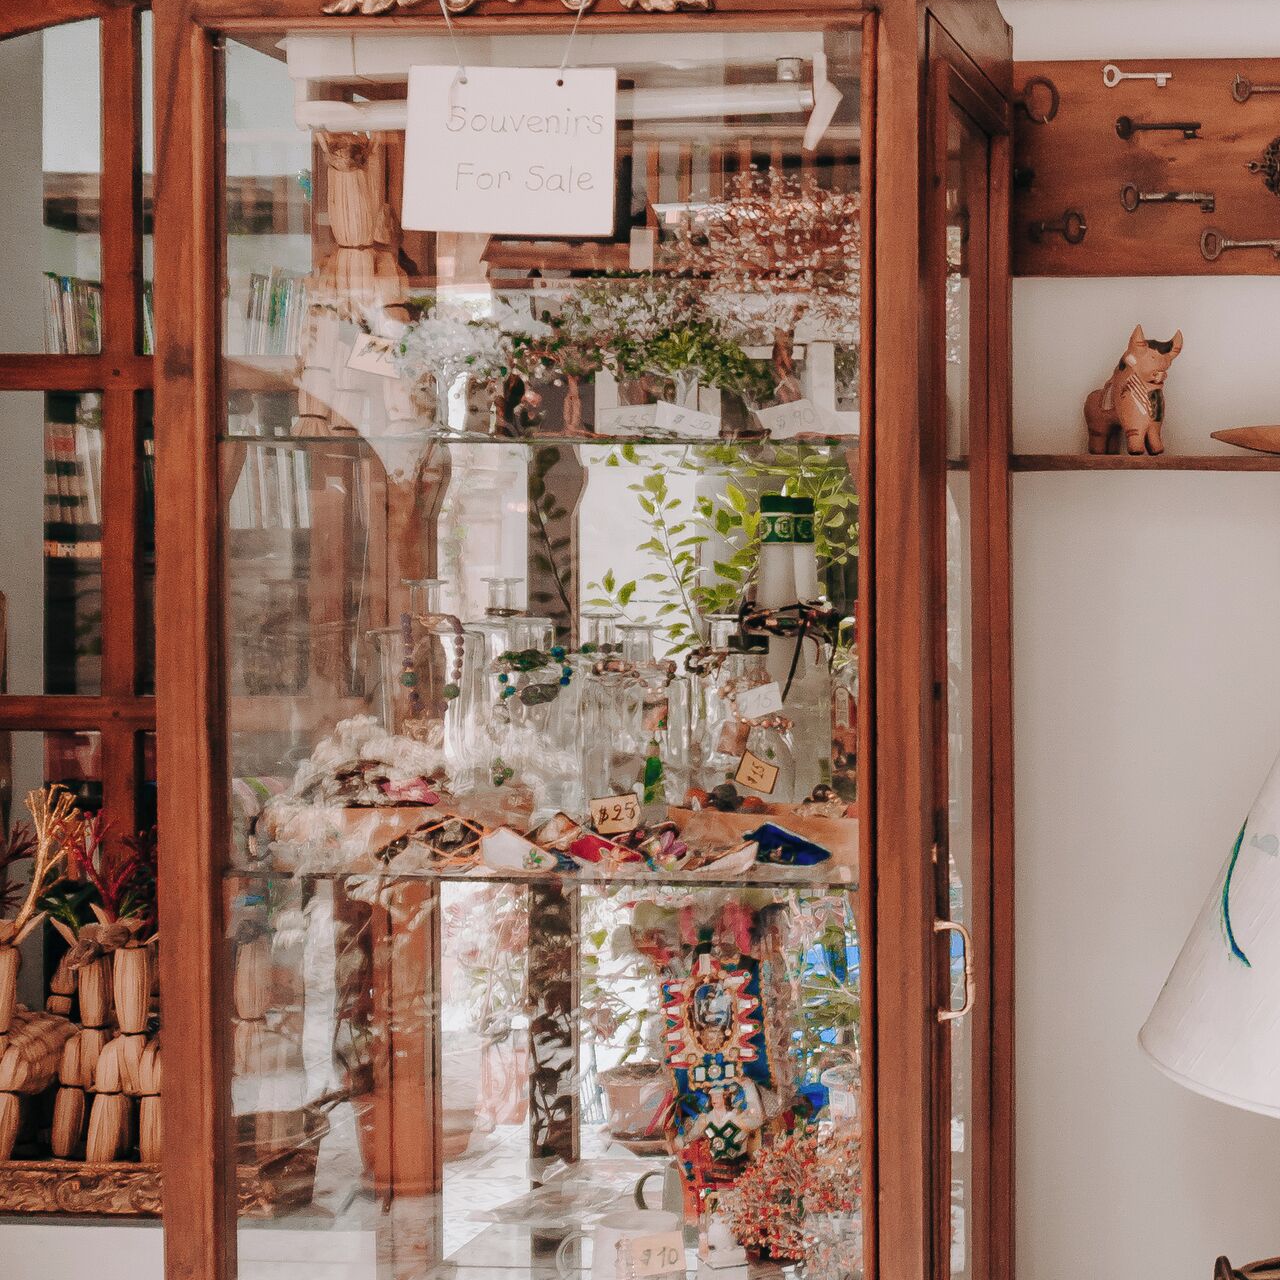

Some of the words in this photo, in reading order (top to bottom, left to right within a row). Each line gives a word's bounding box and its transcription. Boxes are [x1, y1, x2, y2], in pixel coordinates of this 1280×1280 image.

[445, 105, 604, 135] Souvenirs
[455, 162, 511, 191] For
[525, 165, 594, 193] Sale
